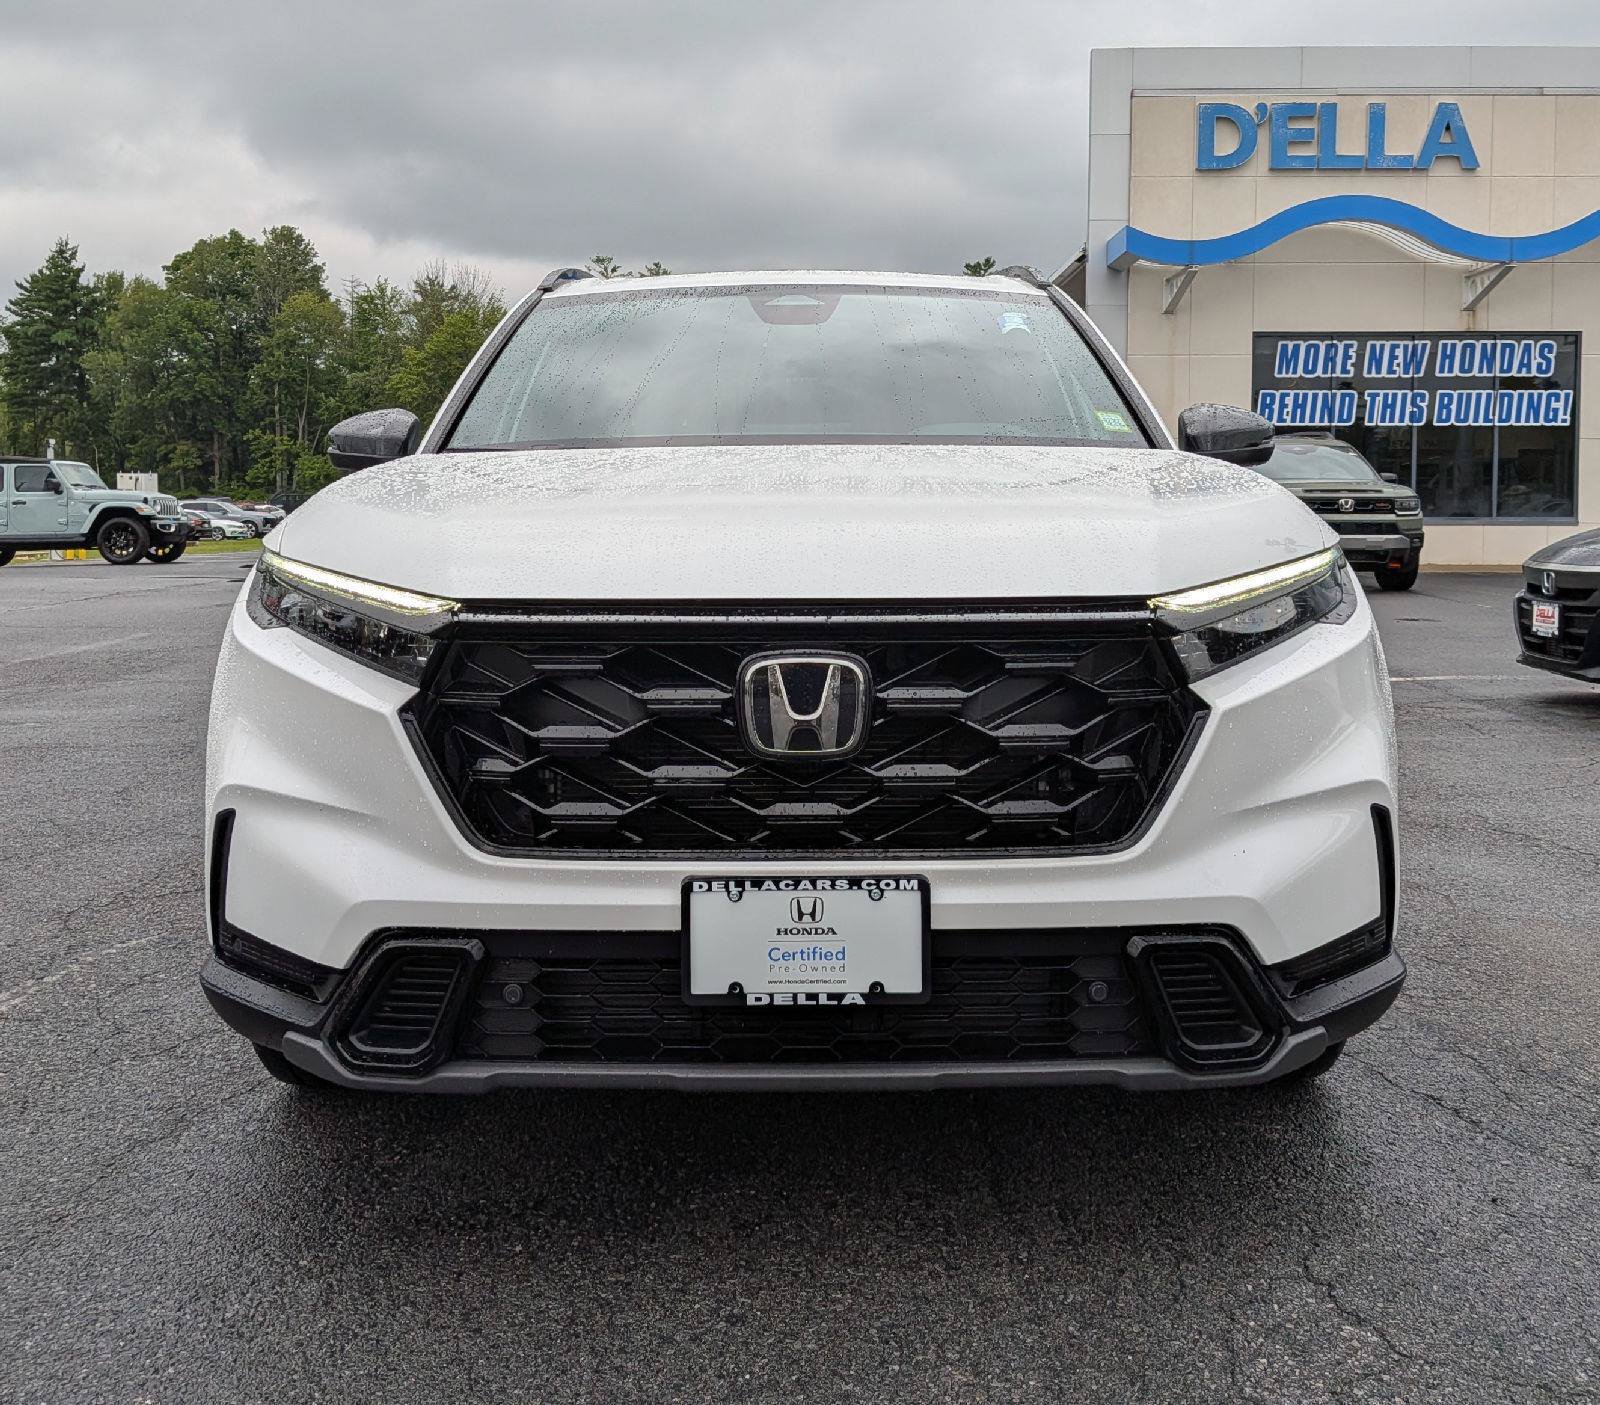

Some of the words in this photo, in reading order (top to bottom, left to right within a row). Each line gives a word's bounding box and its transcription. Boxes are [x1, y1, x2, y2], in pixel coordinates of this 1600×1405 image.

[1196, 102, 1480, 169] D'ELLA
[1274, 340, 1358, 378] MORE
[1363, 340, 1430, 378] NEW
[1435, 340, 1557, 377] HONDAS
[1257, 389, 1358, 426] BEHIND
[1364, 389, 1429, 426] THIS
[1433, 389, 1574, 426] BUILDING!
[692, 879, 918, 892] DELLACARS.COM
[776, 927, 838, 936] HONDA
[768, 946, 846, 961] Certified
[746, 993, 866, 1006] DELLA
